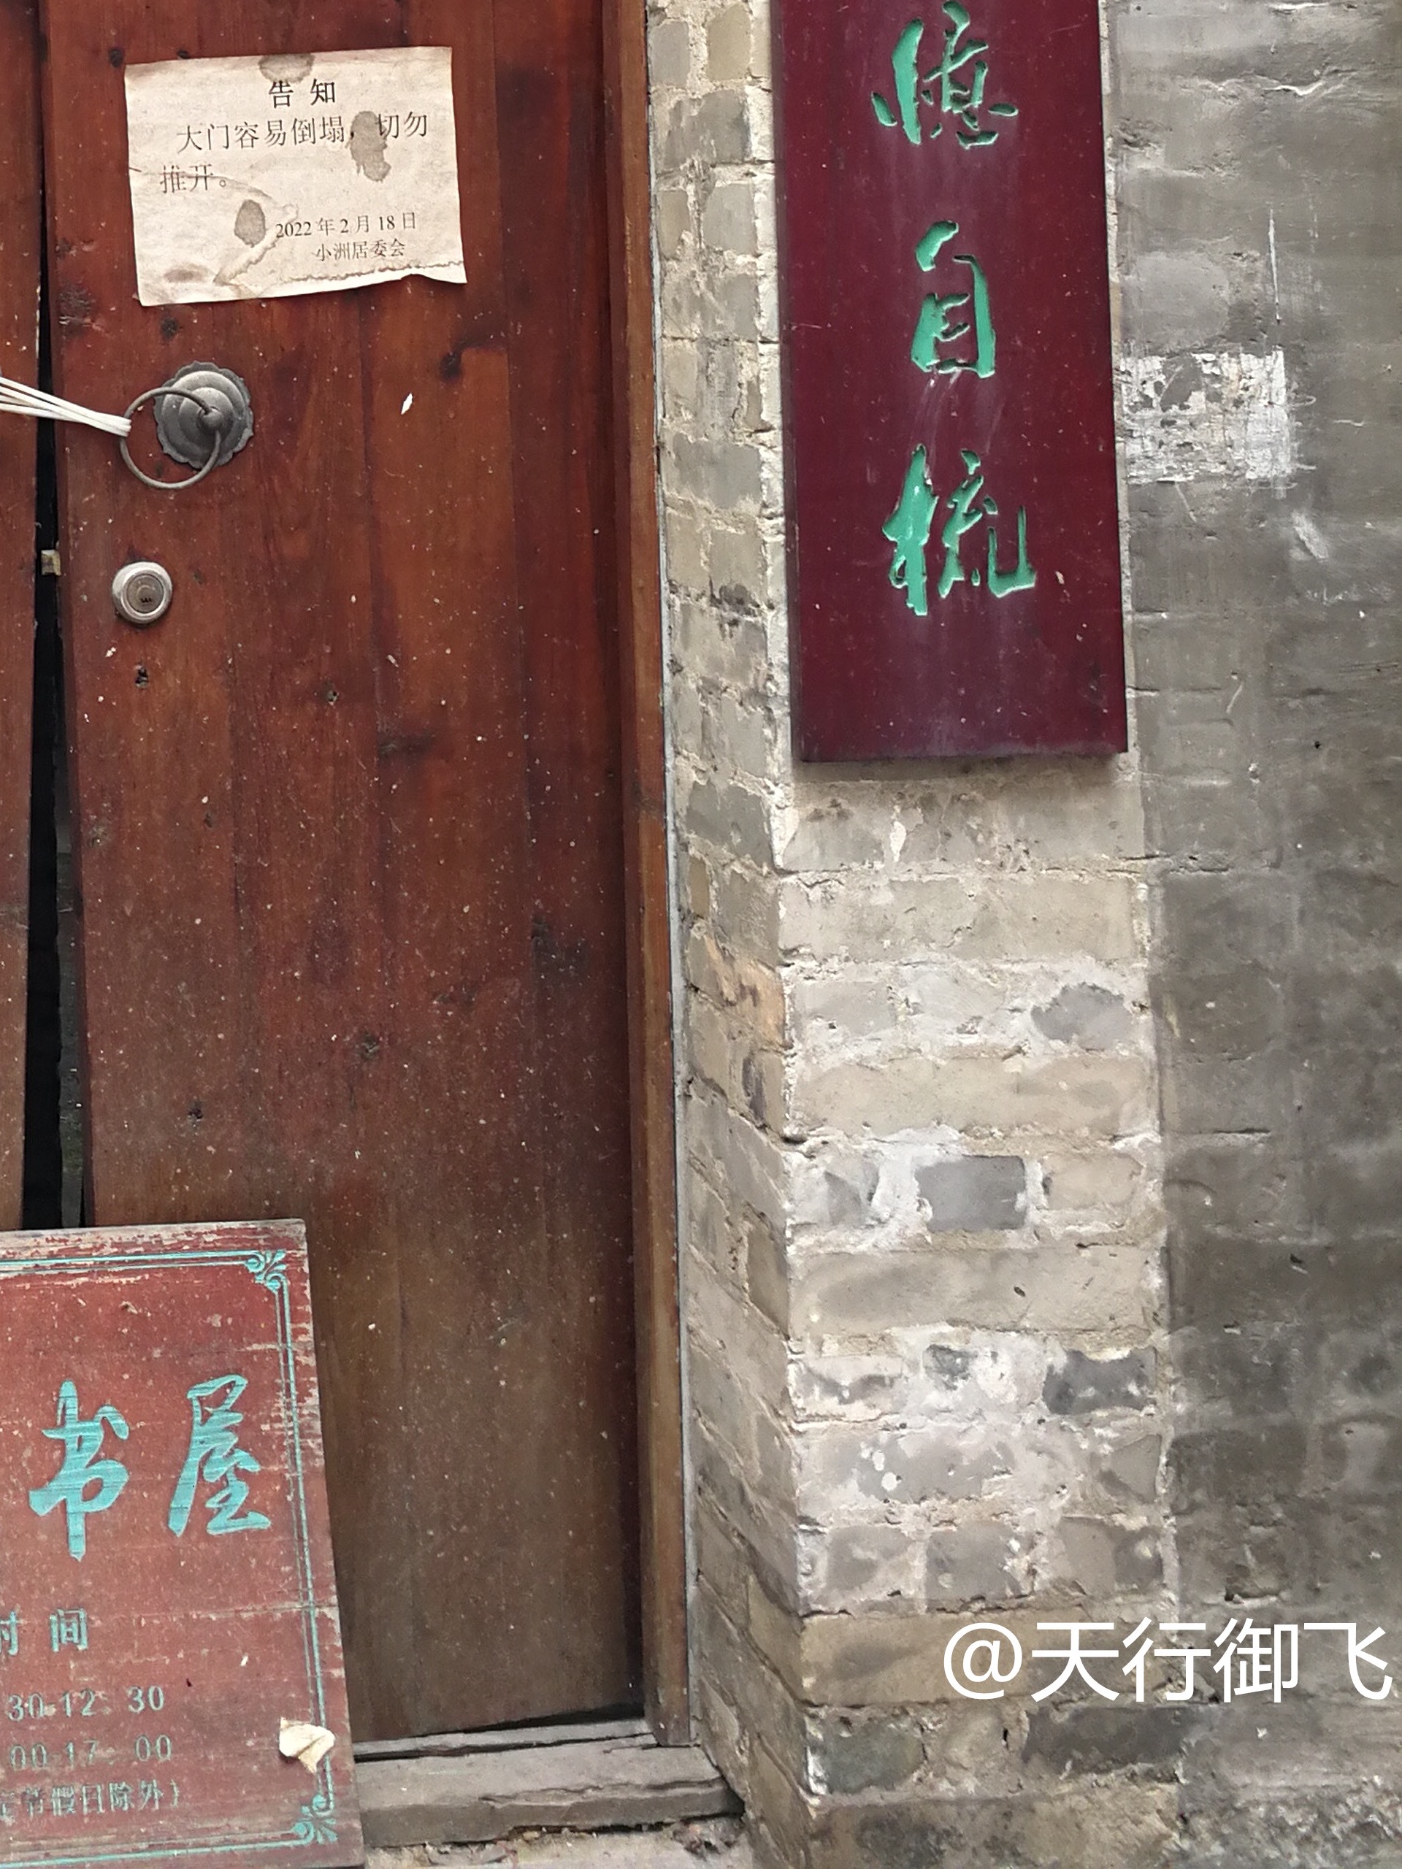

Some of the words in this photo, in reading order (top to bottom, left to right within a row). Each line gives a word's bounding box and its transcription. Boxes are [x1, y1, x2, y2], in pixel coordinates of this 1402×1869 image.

[268, 77, 337, 109] 告知
[176, 111, 429, 155] 大门容易倒塌，切勿
[160, 162, 230, 194] 推开。
[274, 211, 417, 239] 2022年2月18日
[314, 237, 406, 263] 小洲居委会
